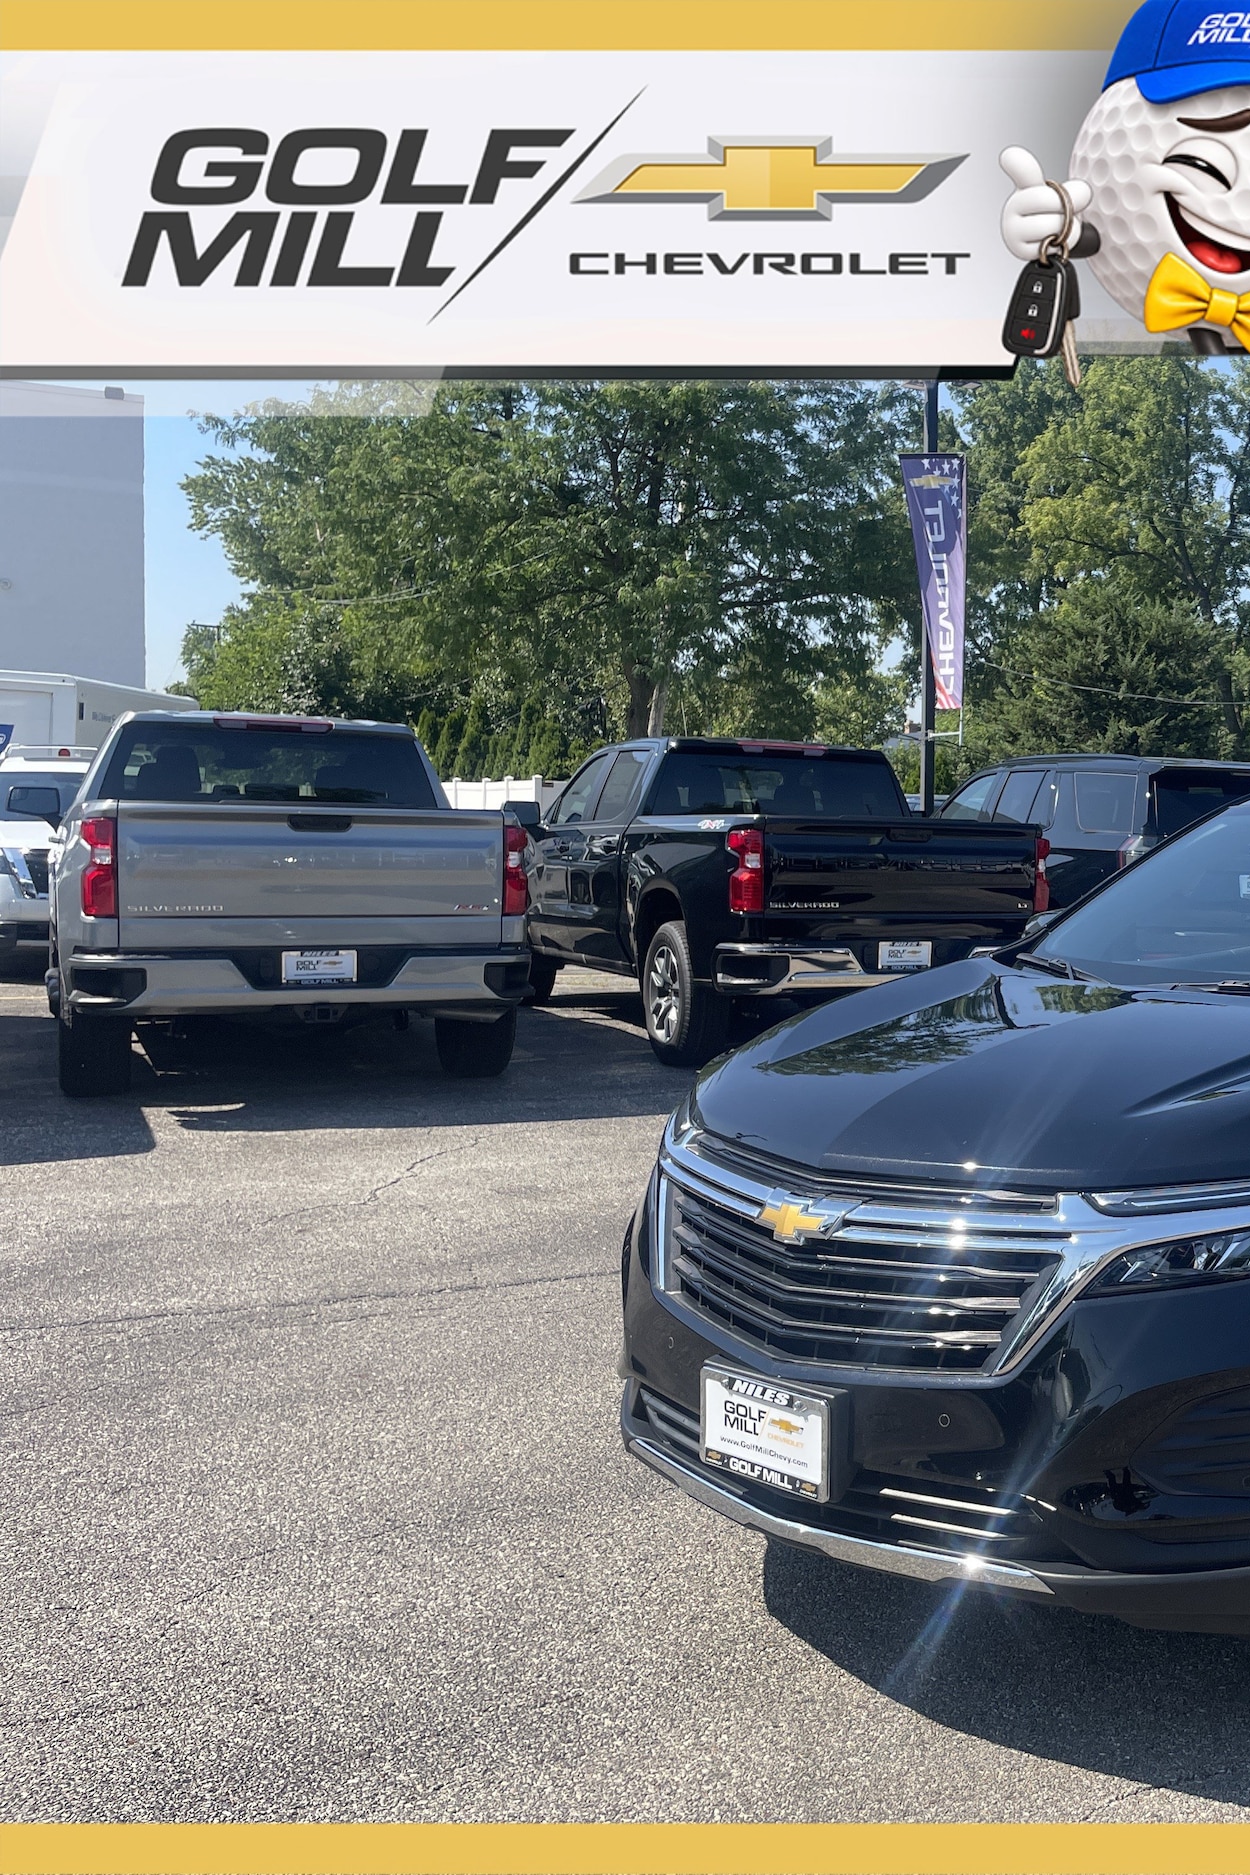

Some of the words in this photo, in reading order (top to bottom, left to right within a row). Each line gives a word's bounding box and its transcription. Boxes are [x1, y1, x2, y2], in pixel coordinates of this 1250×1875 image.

[769, 901, 840, 909] SILVERADO
[731, 1379, 791, 1406] NILES
[724, 1400, 767, 1422] GOLF
[724, 1414, 759, 1436] MILL
[729, 1458, 763, 1478] GOLF
[762, 1469, 793, 1490] MILL
